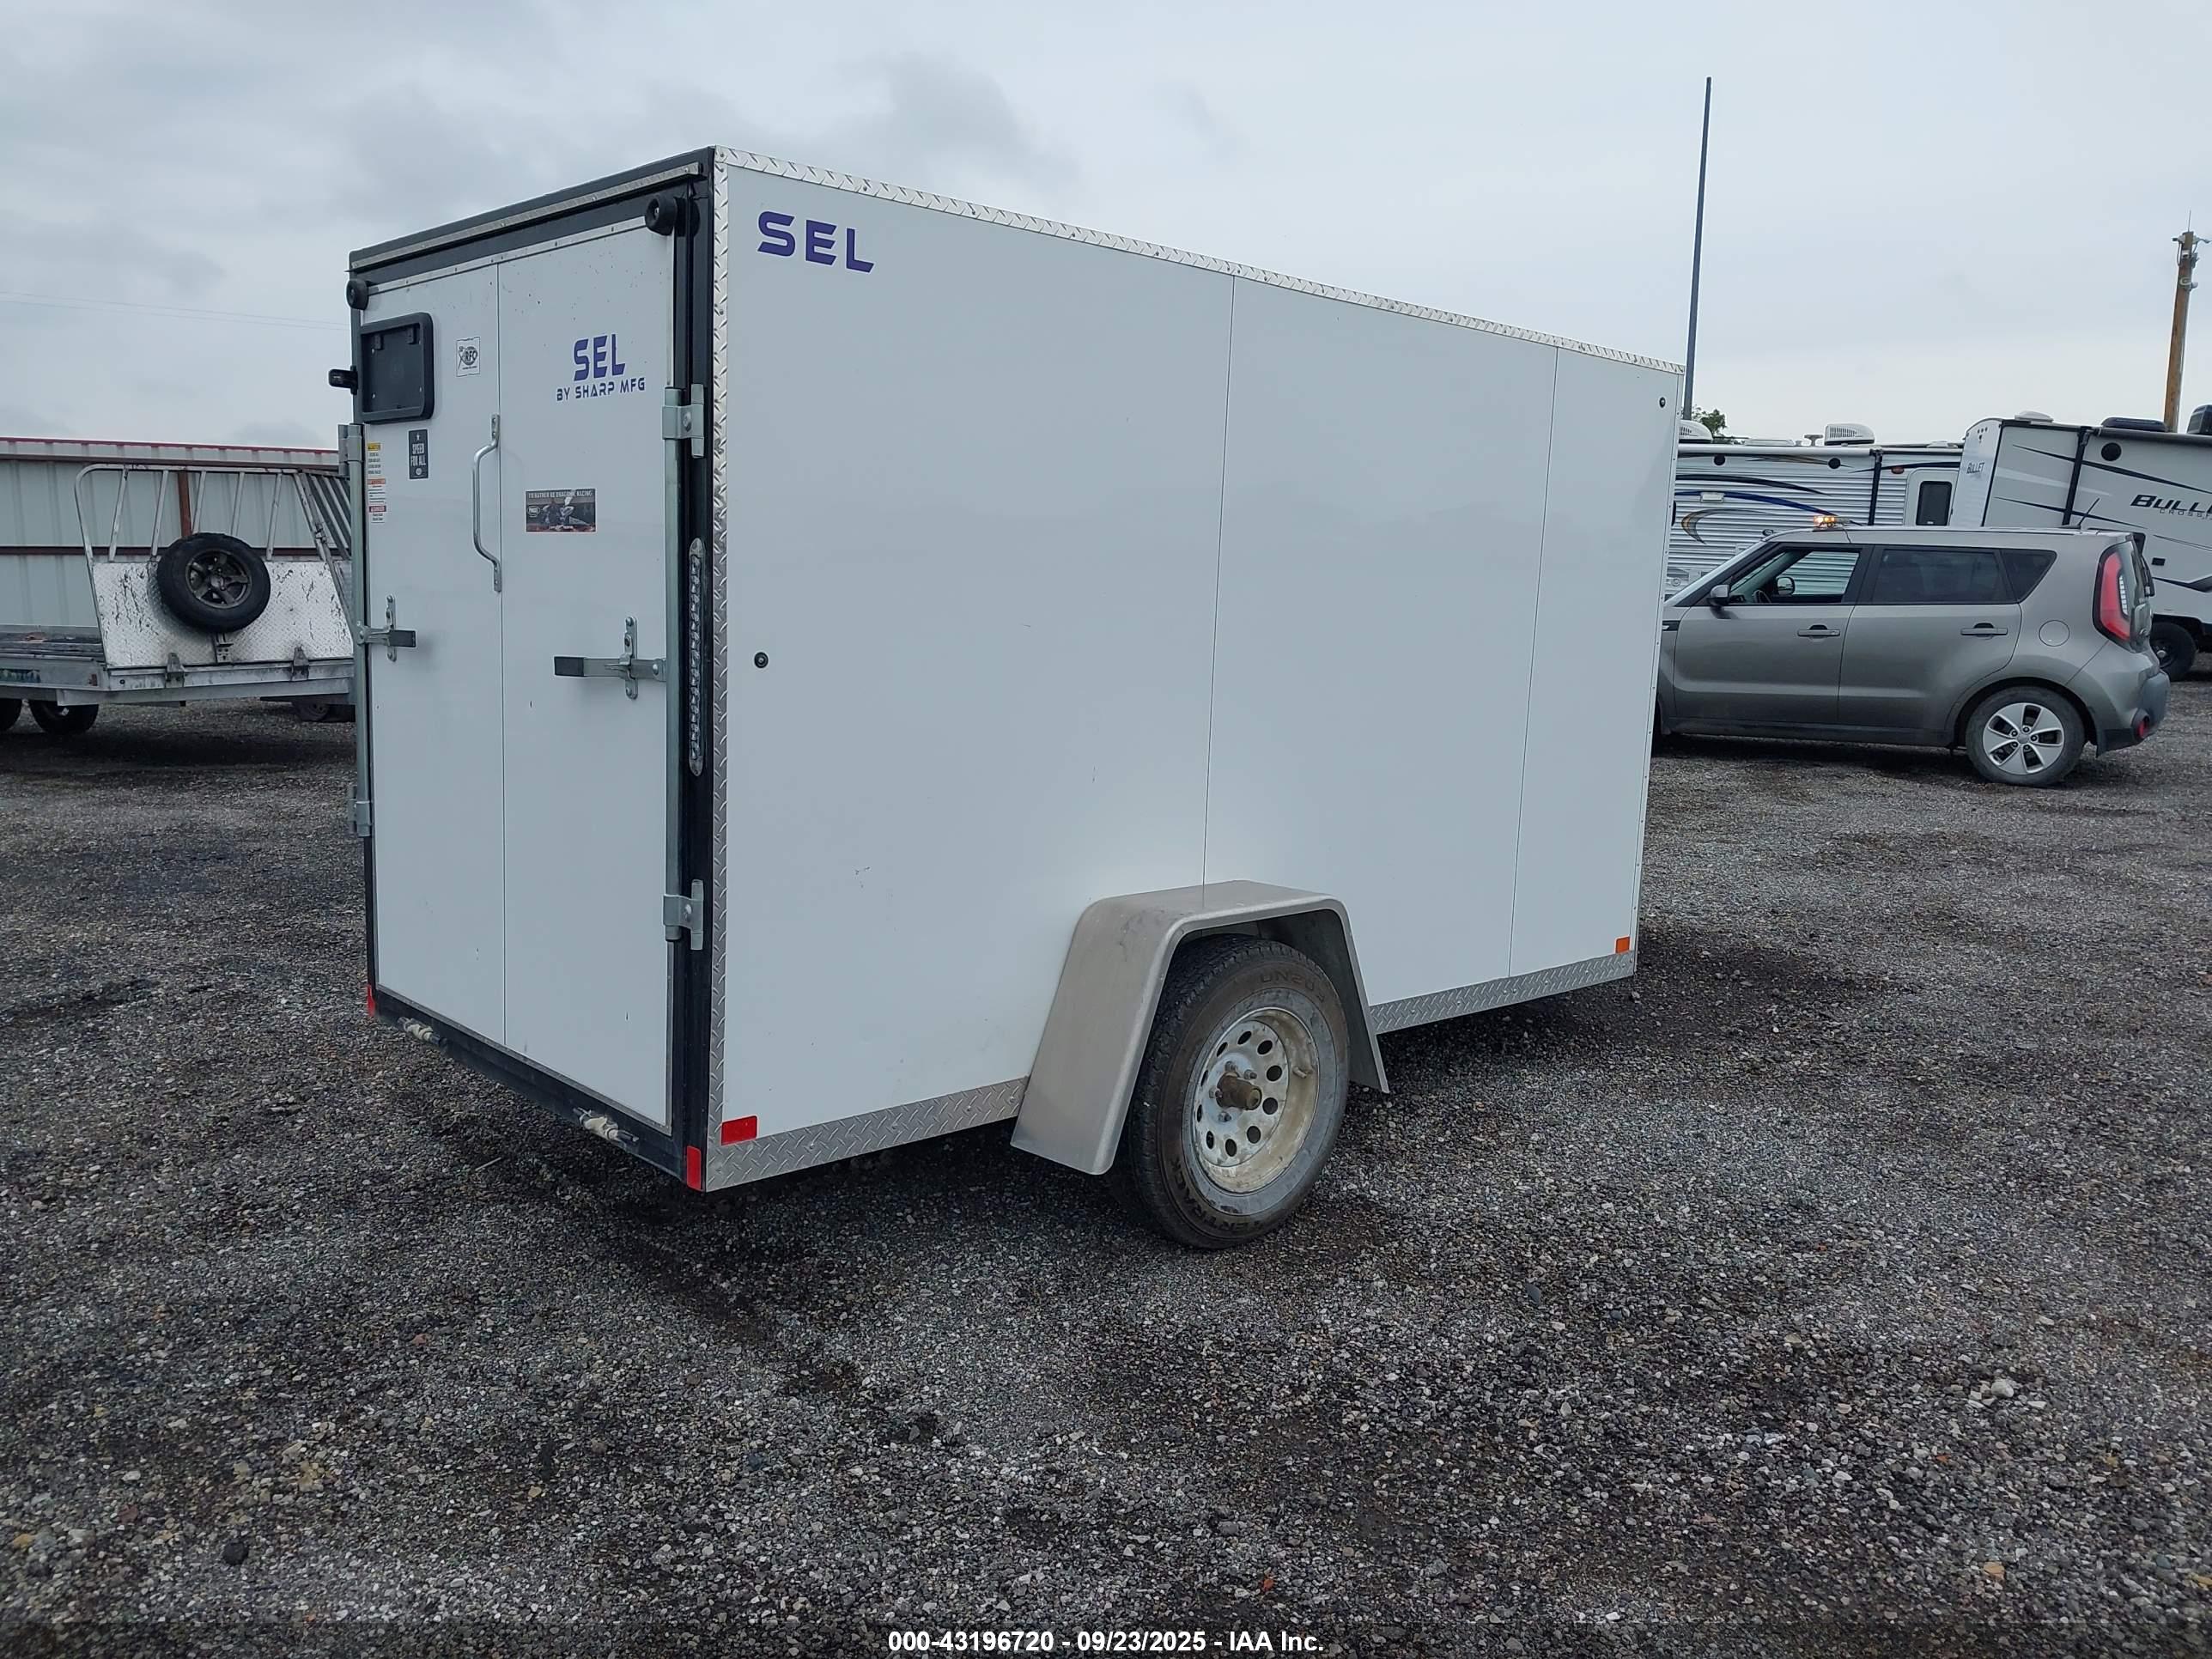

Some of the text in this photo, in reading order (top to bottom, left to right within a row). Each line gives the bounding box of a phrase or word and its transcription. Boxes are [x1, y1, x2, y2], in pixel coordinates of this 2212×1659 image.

[757, 210, 875, 273] SEL
[573, 333, 626, 381] SEL
[556, 377, 646, 402] BY SHARP MFG
[412, 443, 425, 454] SPEED
